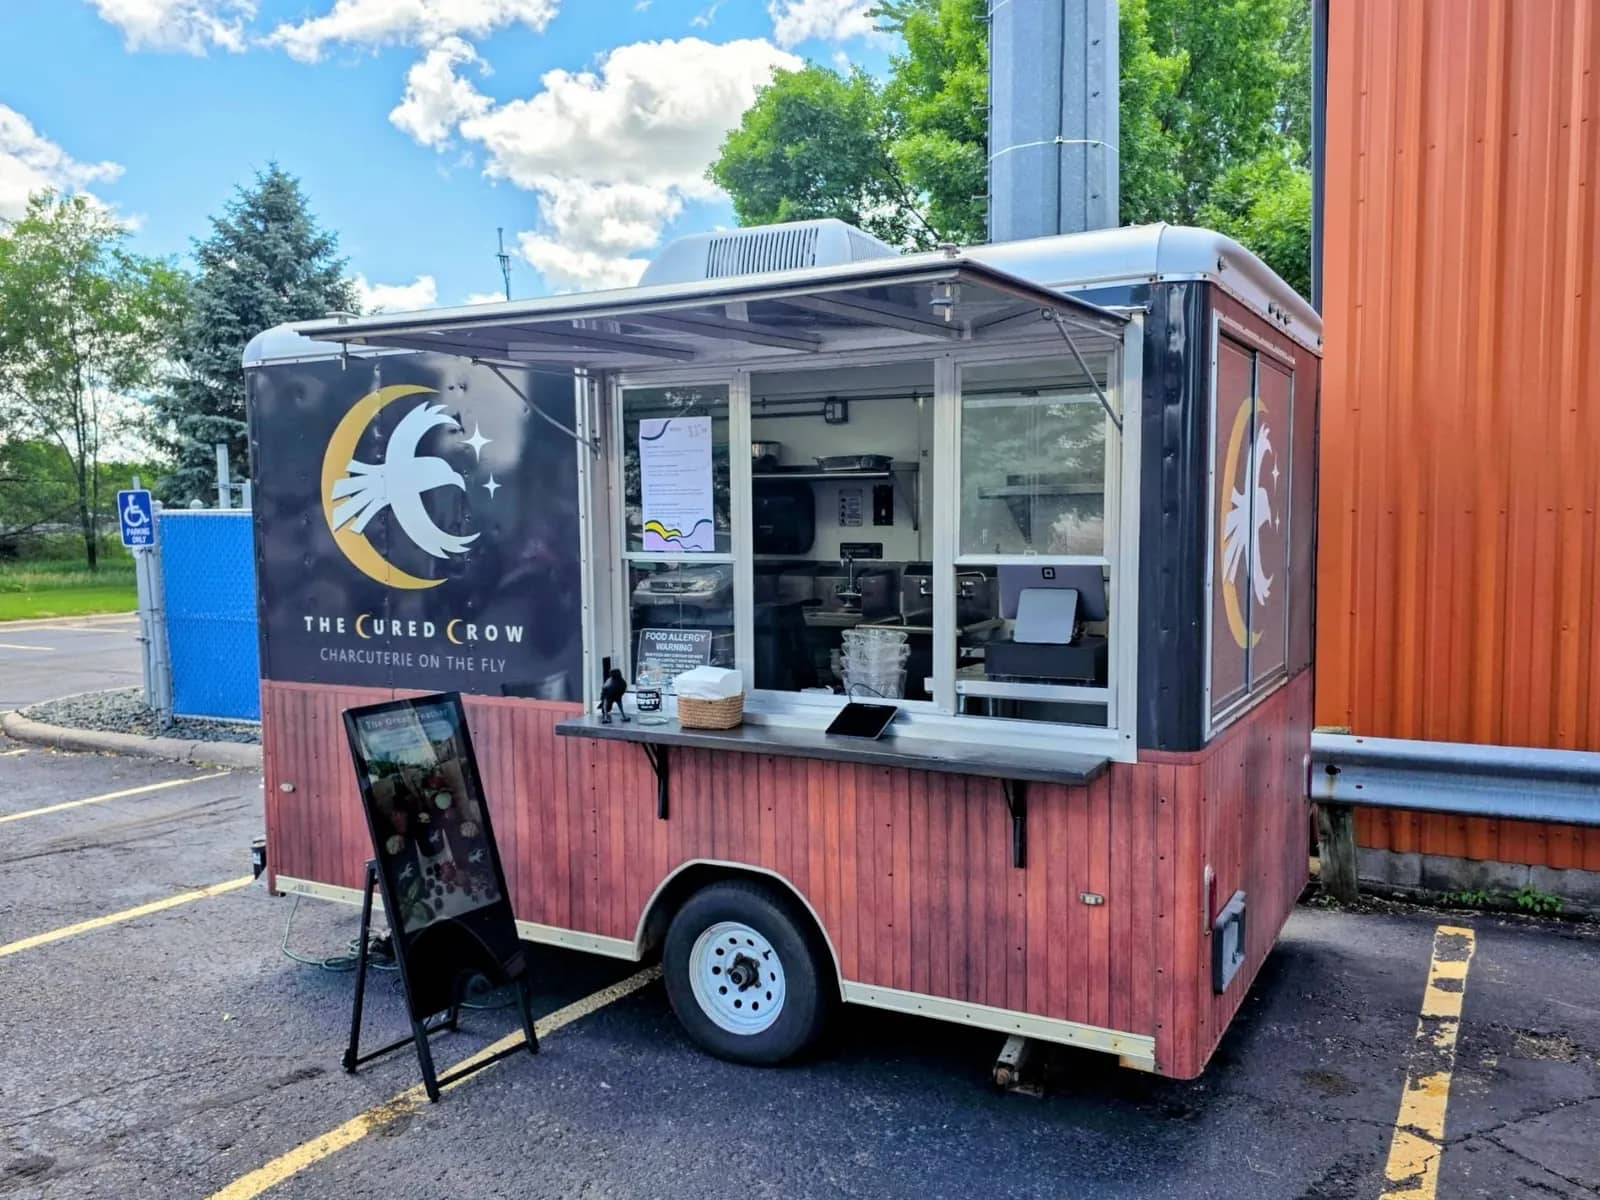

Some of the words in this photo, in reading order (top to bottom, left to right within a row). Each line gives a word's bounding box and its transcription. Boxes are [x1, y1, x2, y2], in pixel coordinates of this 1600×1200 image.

[126, 527, 150, 536] PARKING
[131, 536, 147, 544] ONLY
[303, 615, 346, 633] THE
[355, 613, 436, 639] CURED
[446, 618, 524, 645] CROW
[645, 632, 668, 640] FOOD
[668, 633, 706, 642] ALLERGY
[655, 642, 693, 652] WARNING
[319, 647, 413, 668] CHARCUTERIE
[418, 654, 441, 669] ON
[446, 656, 475, 671] THE
[481, 658, 506, 673] FLY
